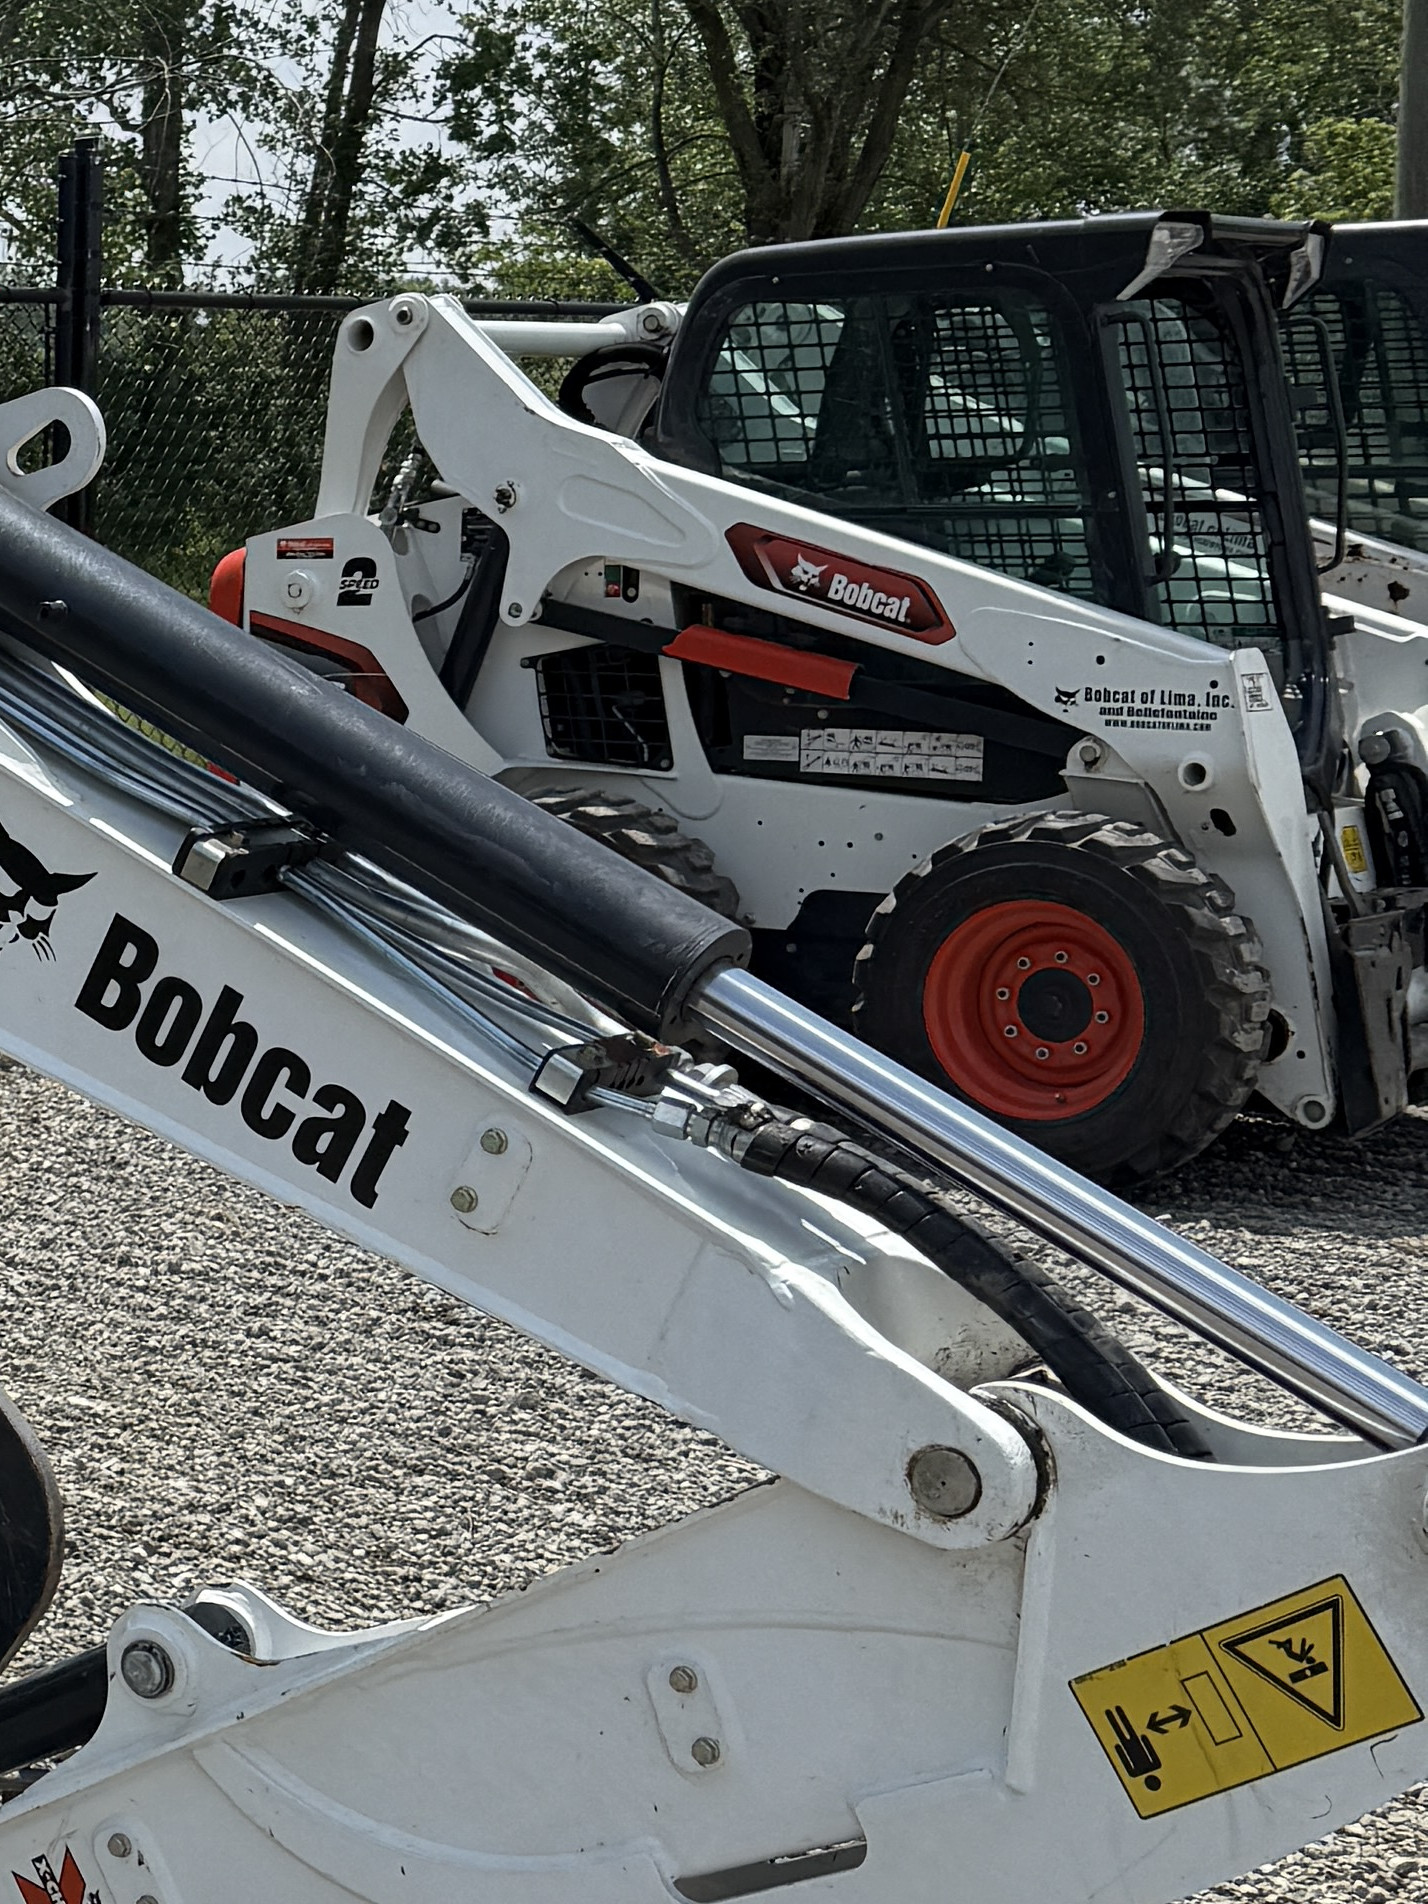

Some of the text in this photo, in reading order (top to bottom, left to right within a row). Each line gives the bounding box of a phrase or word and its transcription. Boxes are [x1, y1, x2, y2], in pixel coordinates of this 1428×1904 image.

[339, 578, 380, 590] SPEED
[826, 572, 912, 624] Bobcat
[1083, 686, 1136, 705] Bobcat
[1140, 688, 1156, 706] of
[1204, 691, 1236, 709] Inc.
[1098, 705, 1219, 721] and Bellefontaine
[73, 911, 413, 1210] Bobcat
